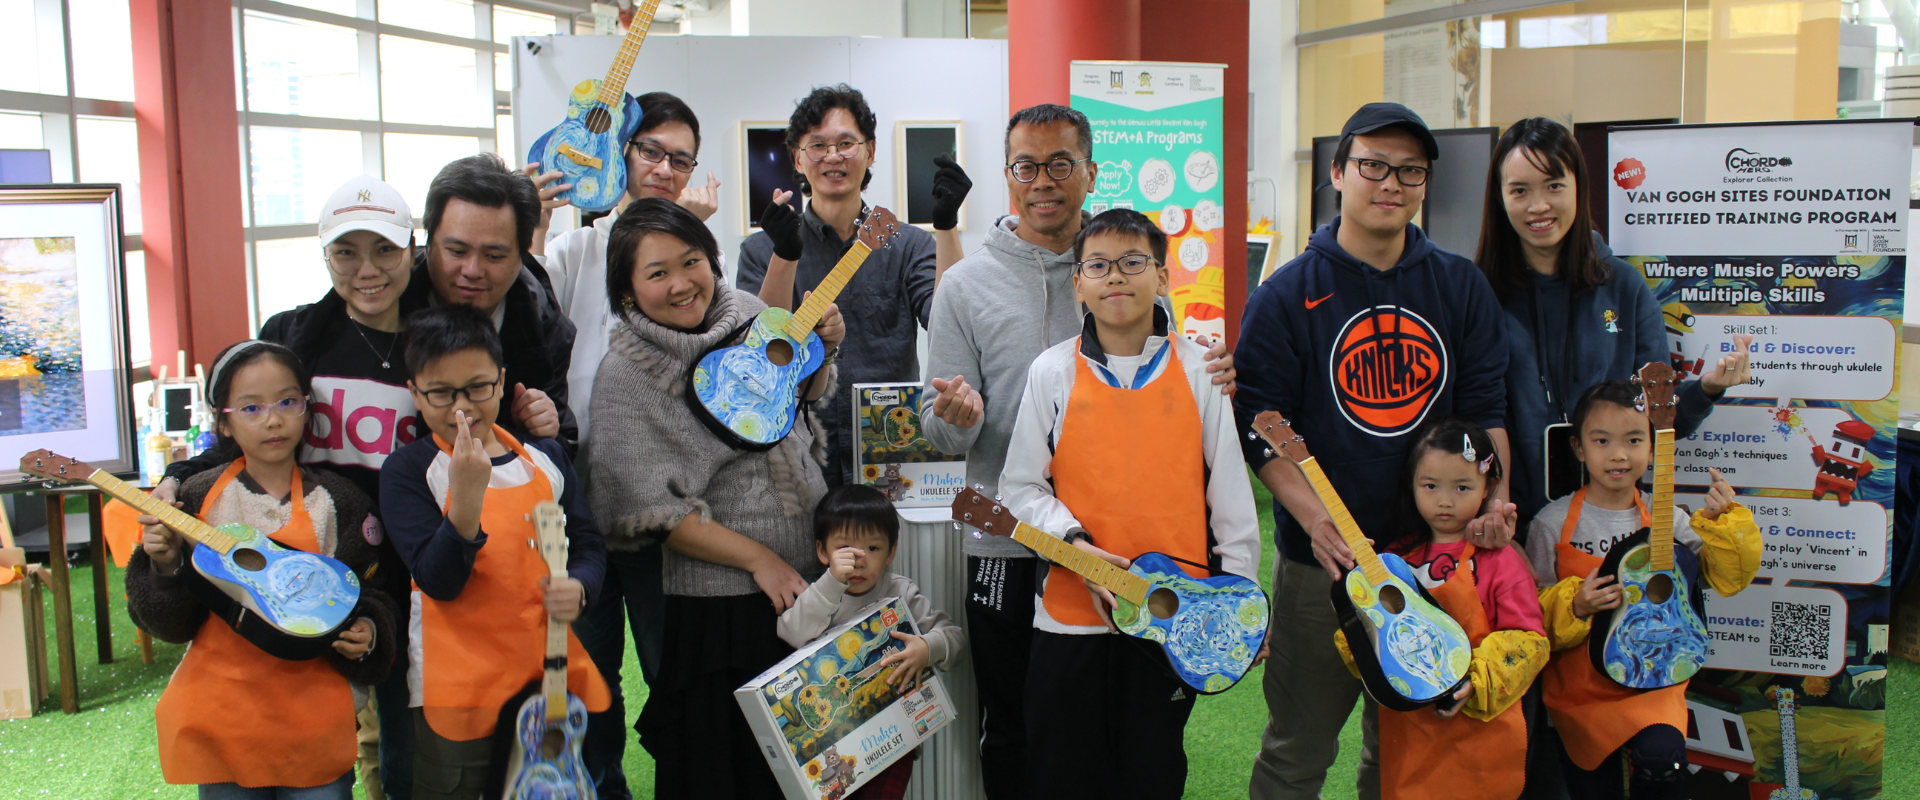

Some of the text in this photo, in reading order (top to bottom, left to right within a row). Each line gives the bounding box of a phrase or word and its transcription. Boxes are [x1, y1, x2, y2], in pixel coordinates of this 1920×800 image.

[1147, 131, 1203, 150] Programs
[1730, 157, 1778, 168] CHORD
[1098, 170, 1122, 181] Apply
[1617, 167, 1642, 181] NEW!
[1723, 176, 1754, 184] Explorer
[1100, 181, 1121, 190] Now!
[1627, 188, 1891, 203] VAN GOGH SITES FOUNDATION
[1625, 211, 1897, 225] CERTIFIED TRAINING PROGRAM
[1645, 262, 1859, 278] Where Music Powers
[1681, 287, 1826, 305] Multiple Skills
[1724, 325, 1778, 335] Skill Set 1:
[1764, 343, 1776, 352] &
[1782, 343, 1856, 355] Discover:
[1345, 342, 1432, 400] KNICKS
[1750, 361, 1882, 374] students through ukulele
[1687, 431, 1766, 444] & Explore:
[1695, 448, 1729, 460] Gogh's
[1733, 450, 1788, 462] techniques
[920, 473, 964, 486] Maker
[920, 487, 950, 496] UKULELE
[1760, 506, 1778, 516] Set
[1782, 507, 1792, 516] 3:
[1768, 526, 1780, 536] &
[1786, 526, 1856, 540] Connect:
[1764, 543, 1776, 552] to
[1780, 544, 1802, 555] play
[1858, 548, 1868, 556] in
[1761, 558, 1836, 571] ogh's universe
[996, 581, 1004, 604] LEADER
[1708, 631, 1760, 643] STEAM to
[1770, 659, 1826, 670] Learn more
[860, 725, 898, 752] Maker
[865, 734, 904, 765] UKULELE SET
